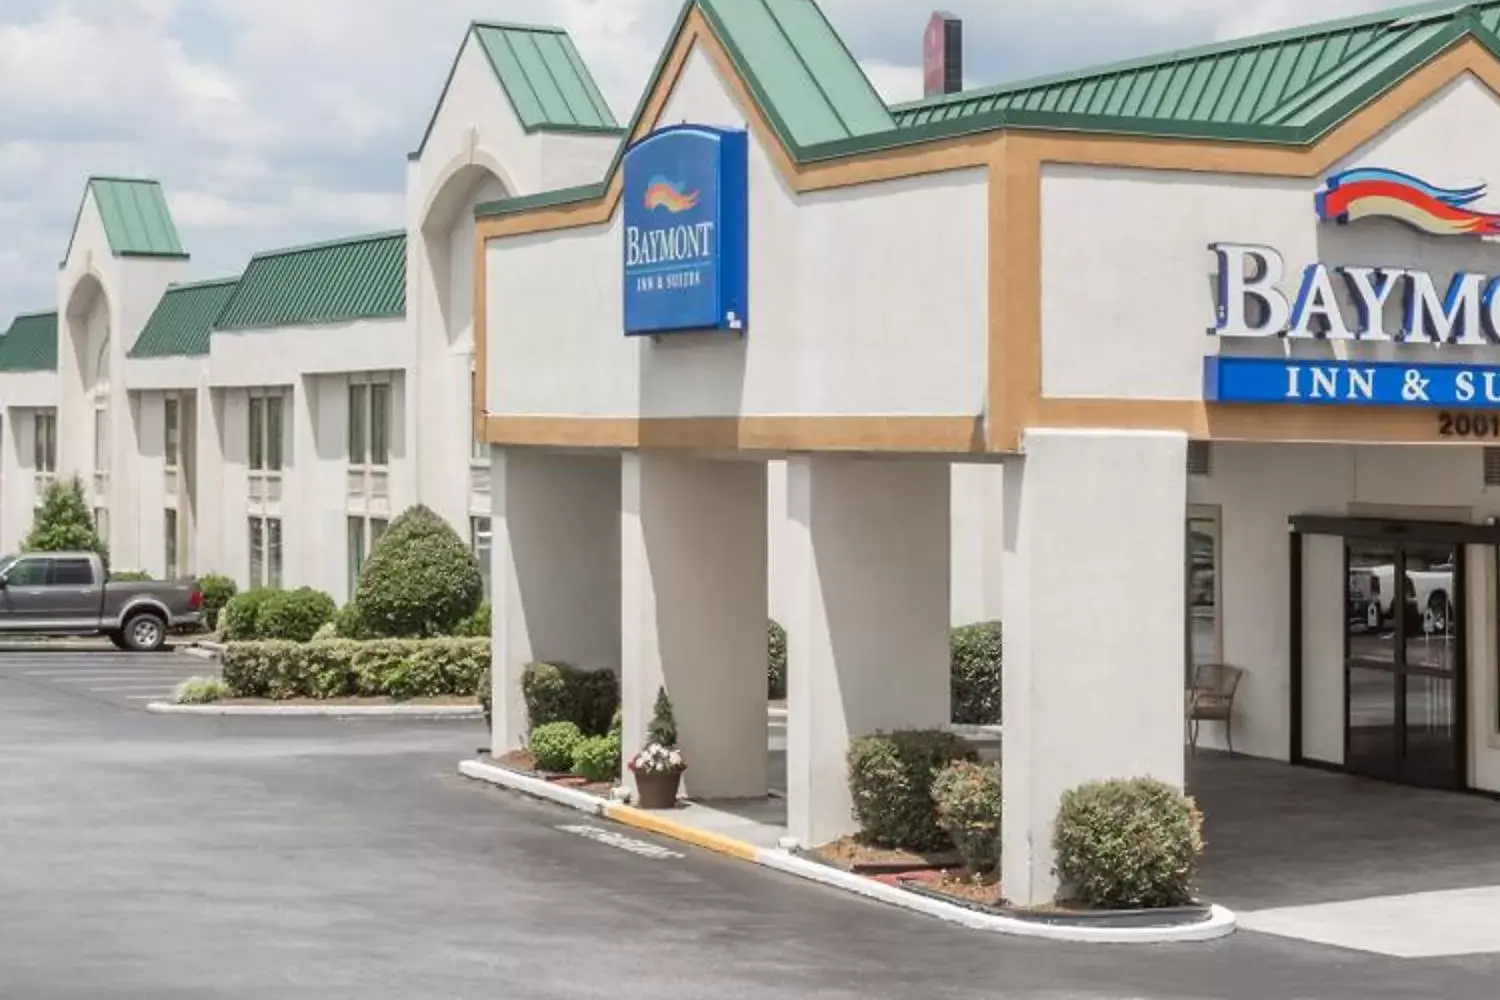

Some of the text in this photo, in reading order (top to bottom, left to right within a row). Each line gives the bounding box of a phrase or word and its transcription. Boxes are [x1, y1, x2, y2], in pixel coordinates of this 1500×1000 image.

[626, 222, 714, 266] BAYMONT
[1285, 365, 1376, 399] INN
[1401, 368, 1431, 401] &
[1437, 412, 1500, 437] 2001
